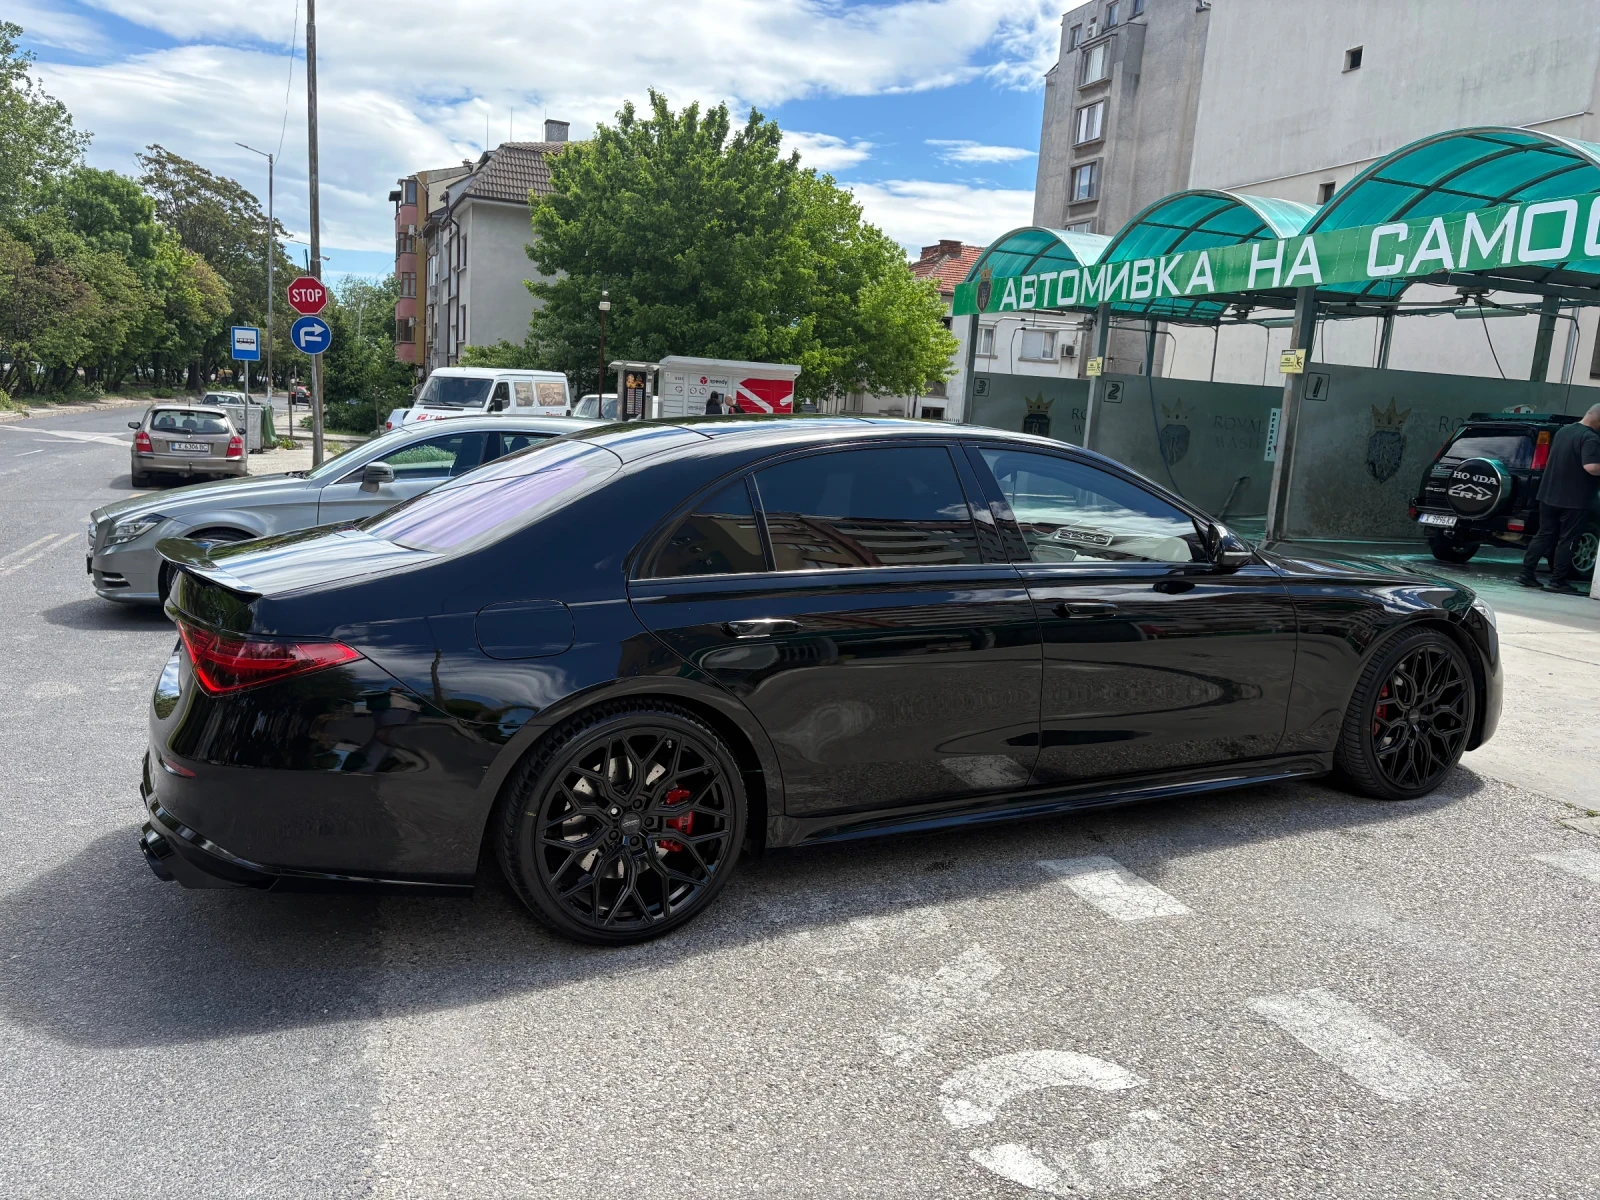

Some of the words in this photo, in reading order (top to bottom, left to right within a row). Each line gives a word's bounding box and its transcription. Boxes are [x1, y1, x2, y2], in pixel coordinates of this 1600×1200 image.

[999, 250, 1215, 311] АВТОМИВКА
[1247, 235, 1323, 289] НА
[292, 288, 323, 303] STOP
[975, 380, 987, 394] 3
[1107, 383, 1121, 400] 2
[1312, 376, 1324, 398] 1
[1213, 415, 1266, 434] ROYAL
[1267, 411, 1277, 457] ПРЕПАРАТ
[1453, 471, 1498, 486] HONDA
[1448, 489, 1493, 500] CR-V
